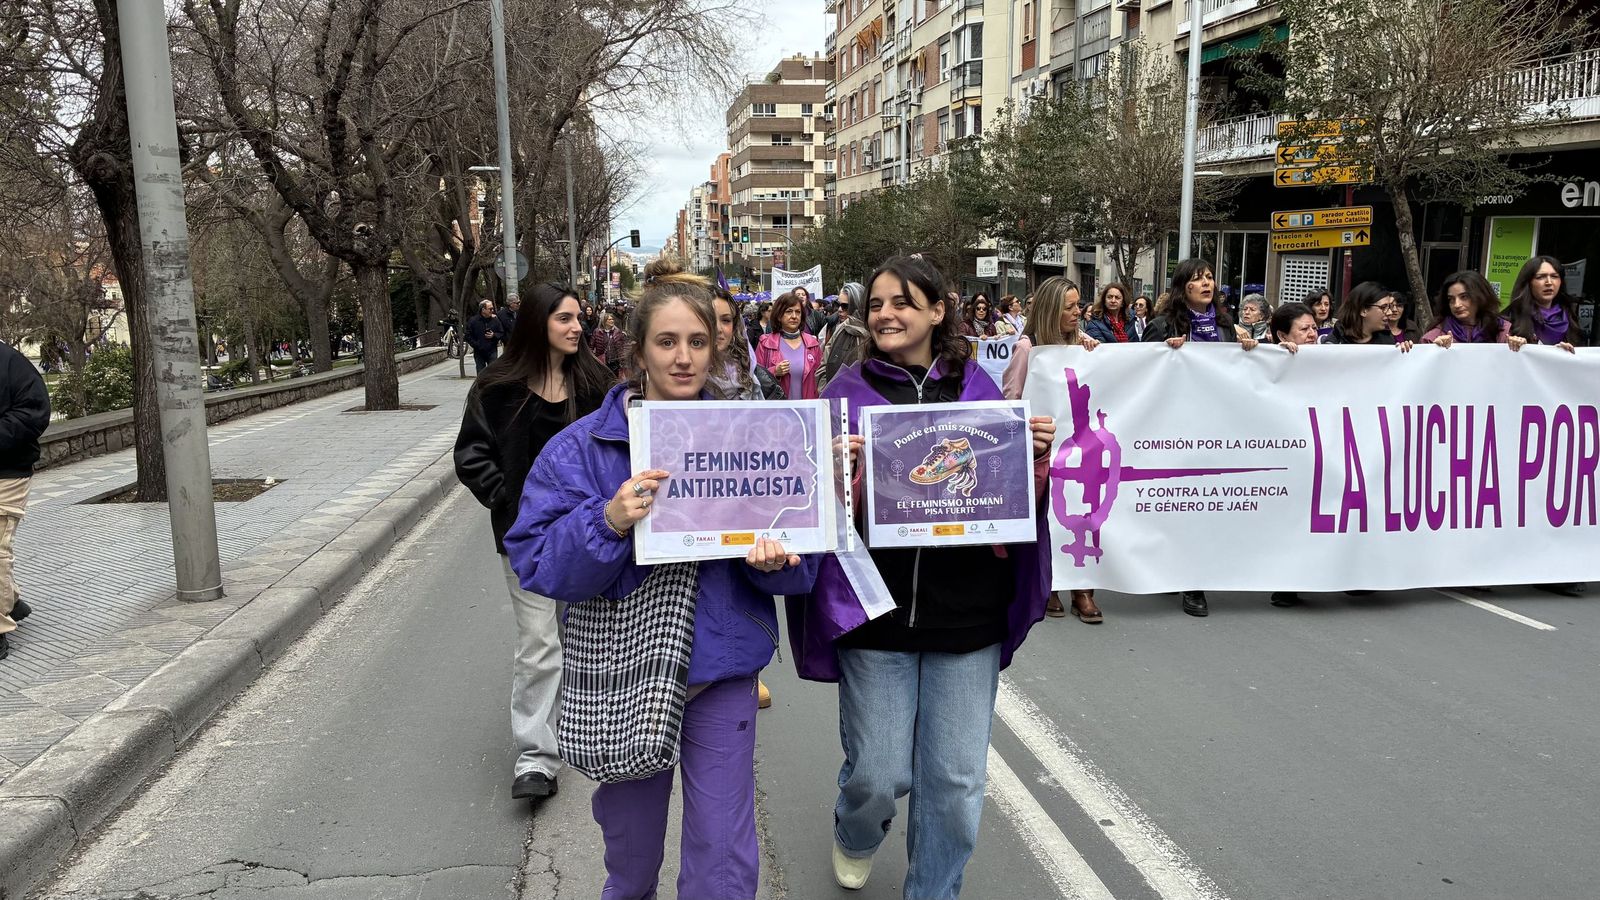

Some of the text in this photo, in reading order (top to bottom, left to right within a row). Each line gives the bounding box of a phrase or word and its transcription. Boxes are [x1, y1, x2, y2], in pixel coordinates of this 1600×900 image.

[1346, 209, 1370, 217] Castillo
[1325, 216, 1370, 225] Santa Catalina
[1273, 240, 1320, 250] ferrocarril
[986, 343, 1009, 360] NO
[893, 421, 1000, 449] Ponte en mis zapatos
[1133, 437, 1307, 450] COMISIÓN POR LA IGUALDAD
[684, 450, 790, 472] FEMINISMO
[1308, 403, 1600, 534] LA LUCHA POR
[667, 476, 806, 499] ANTIRRACISTA
[1136, 486, 1289, 498] Y CONTRA LA VIOLENCIA
[897, 494, 1004, 510] EL FEMINISMO ROMANÍ
[1135, 499, 1258, 512] DE GÉNERO DE JAÉN
[925, 506, 976, 516] PISA FUERTE
